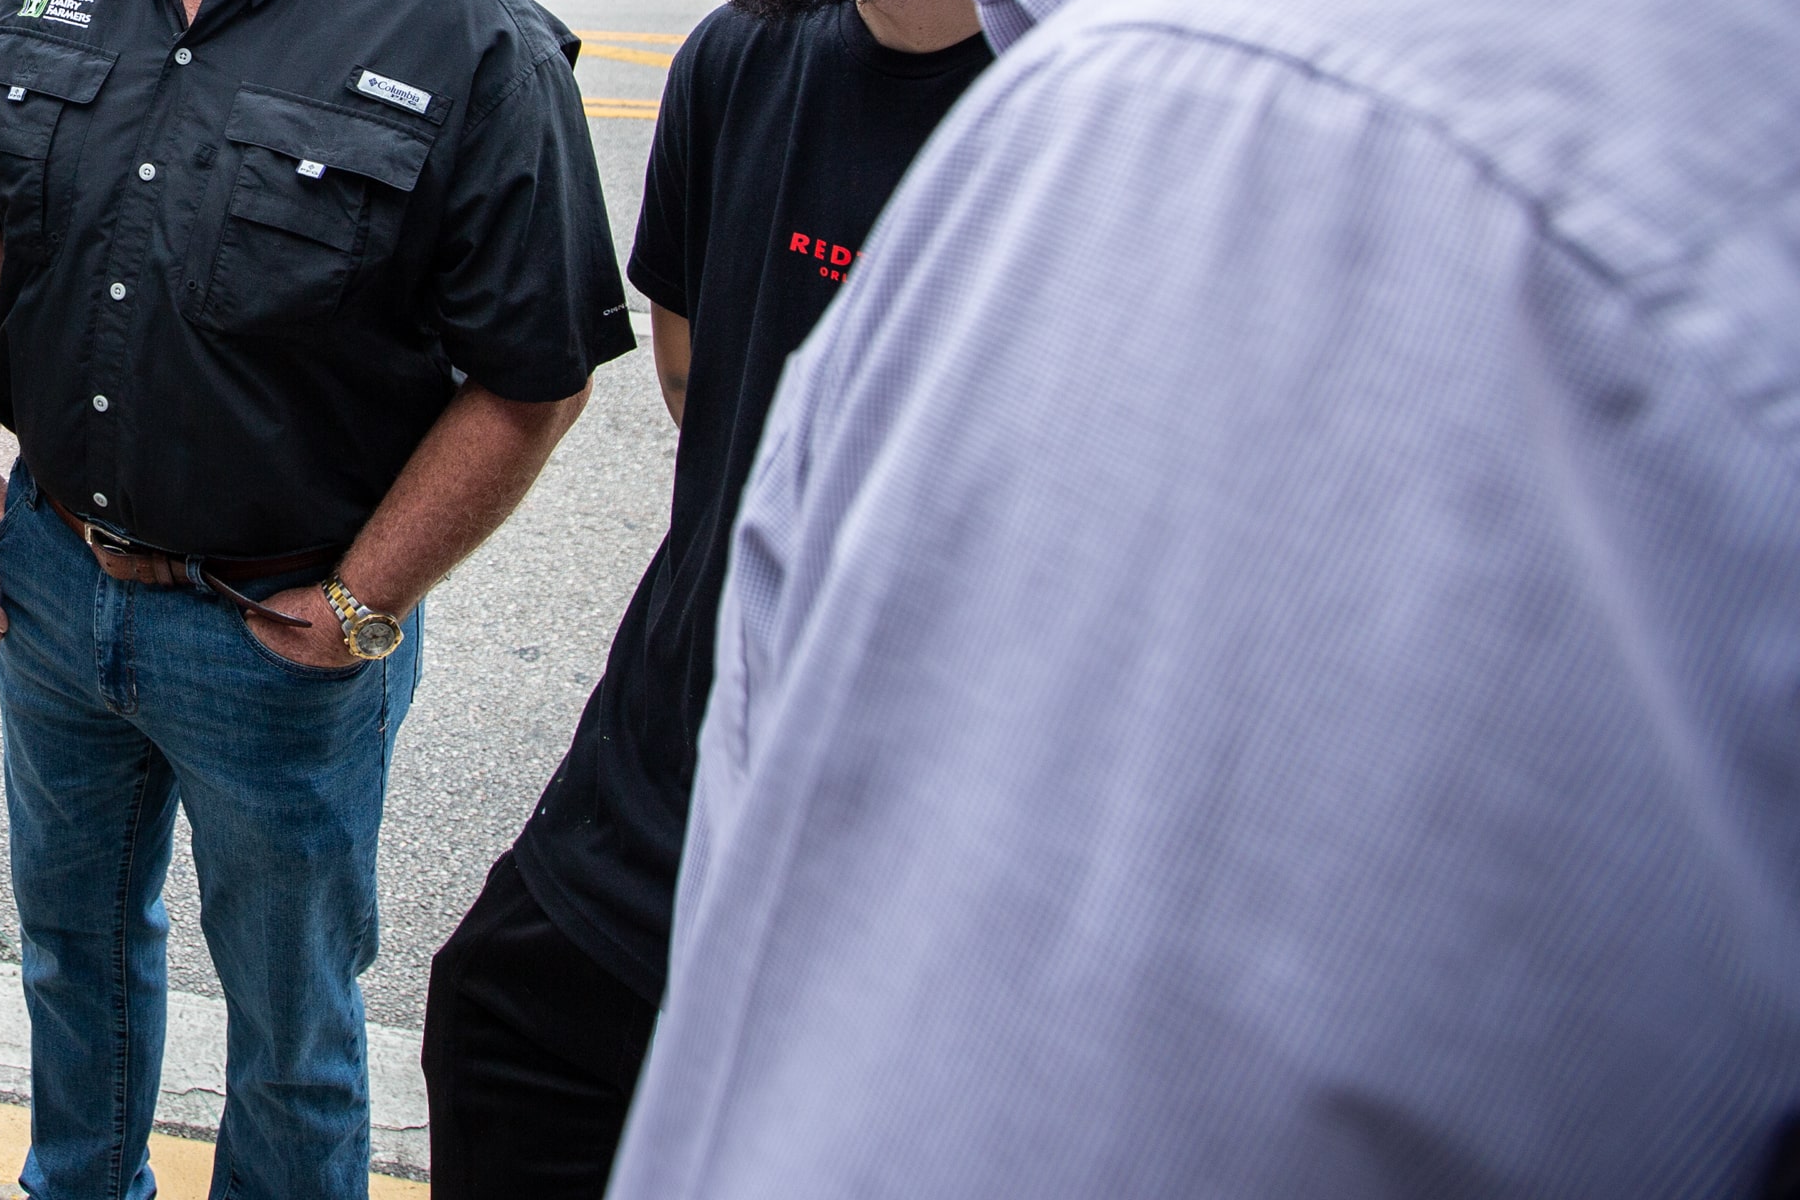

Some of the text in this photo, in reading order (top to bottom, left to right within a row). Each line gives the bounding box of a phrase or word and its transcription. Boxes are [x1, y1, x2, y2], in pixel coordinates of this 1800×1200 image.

[45, 5, 91, 23] FARMERS
[377, 80, 420, 103] Columbia
[789, 232, 866, 266] RED
